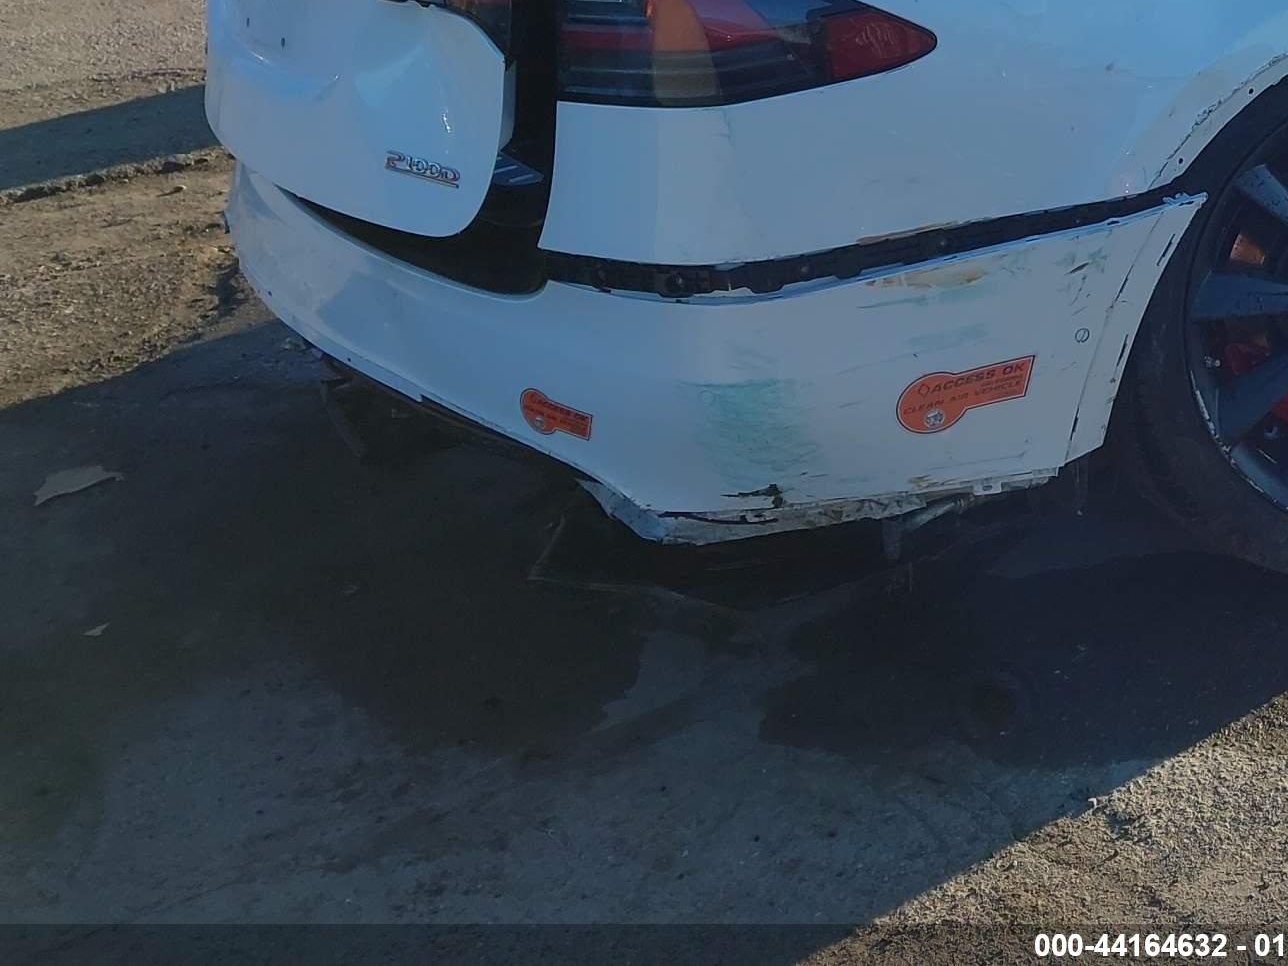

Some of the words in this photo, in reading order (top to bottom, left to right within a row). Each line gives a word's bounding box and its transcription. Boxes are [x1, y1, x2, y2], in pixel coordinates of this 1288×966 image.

[384, 150, 461, 184] P100D
[930, 369, 996, 394] ACCESS
[1002, 363, 1025, 376] OK
[903, 399, 945, 415] CLEAN
